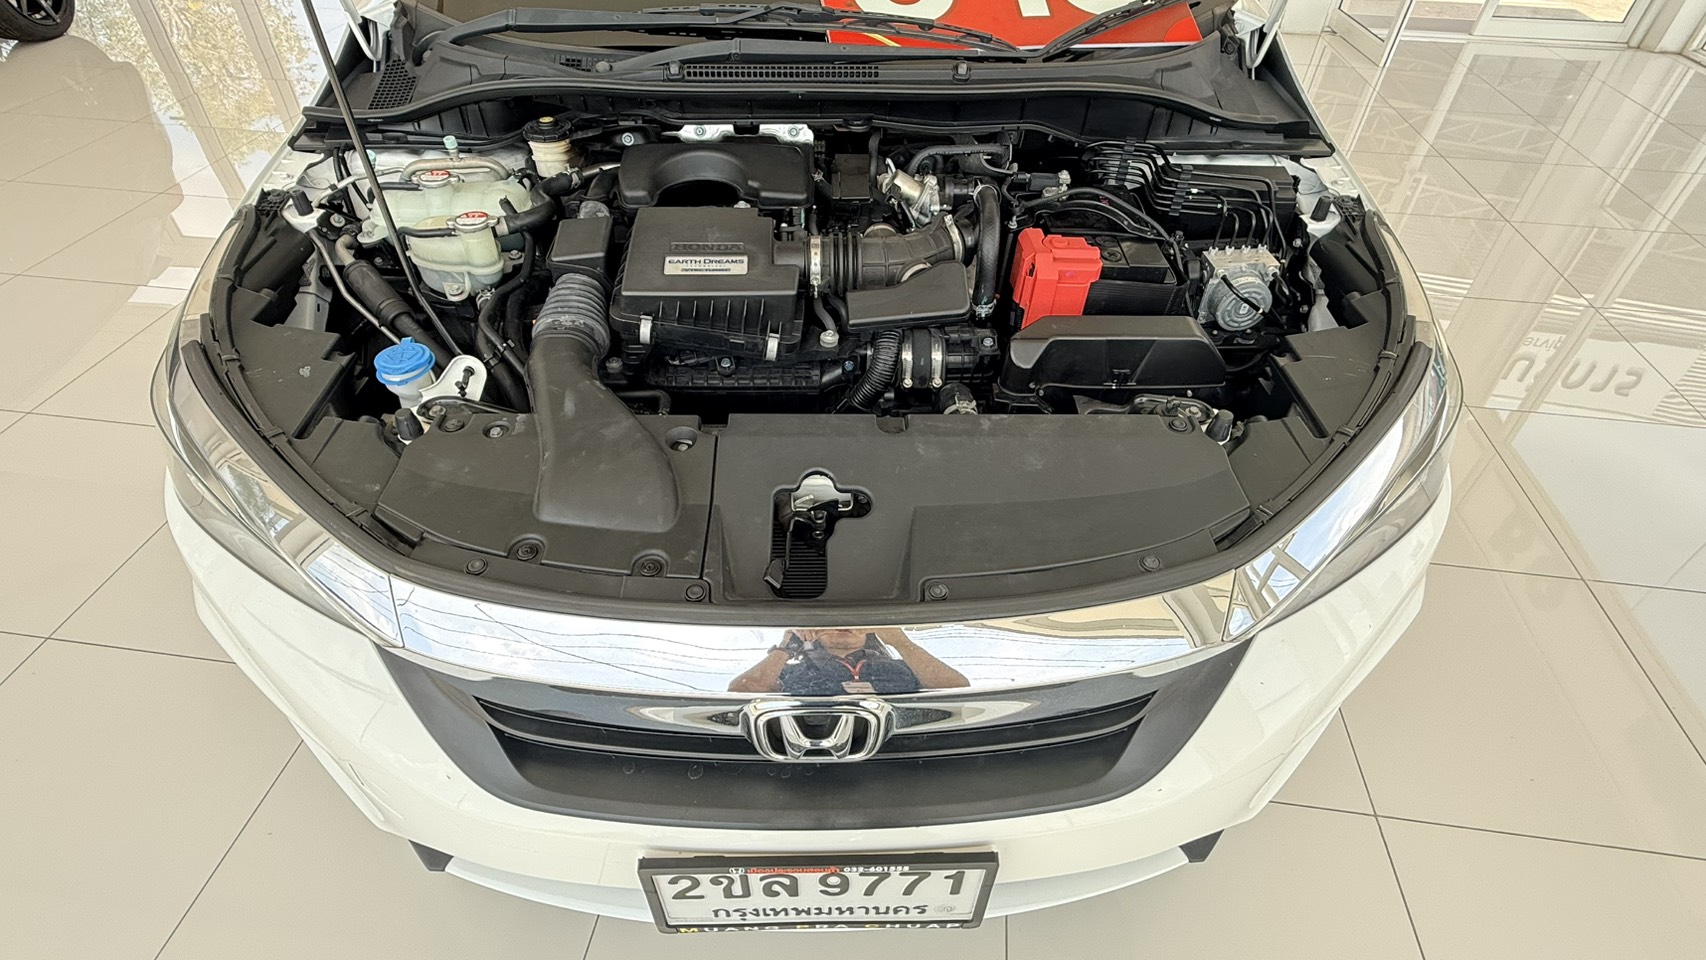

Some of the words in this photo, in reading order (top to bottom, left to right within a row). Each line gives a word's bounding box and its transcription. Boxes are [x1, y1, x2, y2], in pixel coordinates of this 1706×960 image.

[672, 243, 742, 251] HONDA
[668, 873, 799, 899] 2ขล
[818, 871, 966, 896] 9771
[711, 904, 928, 921] กรุงเทพมหานคร
